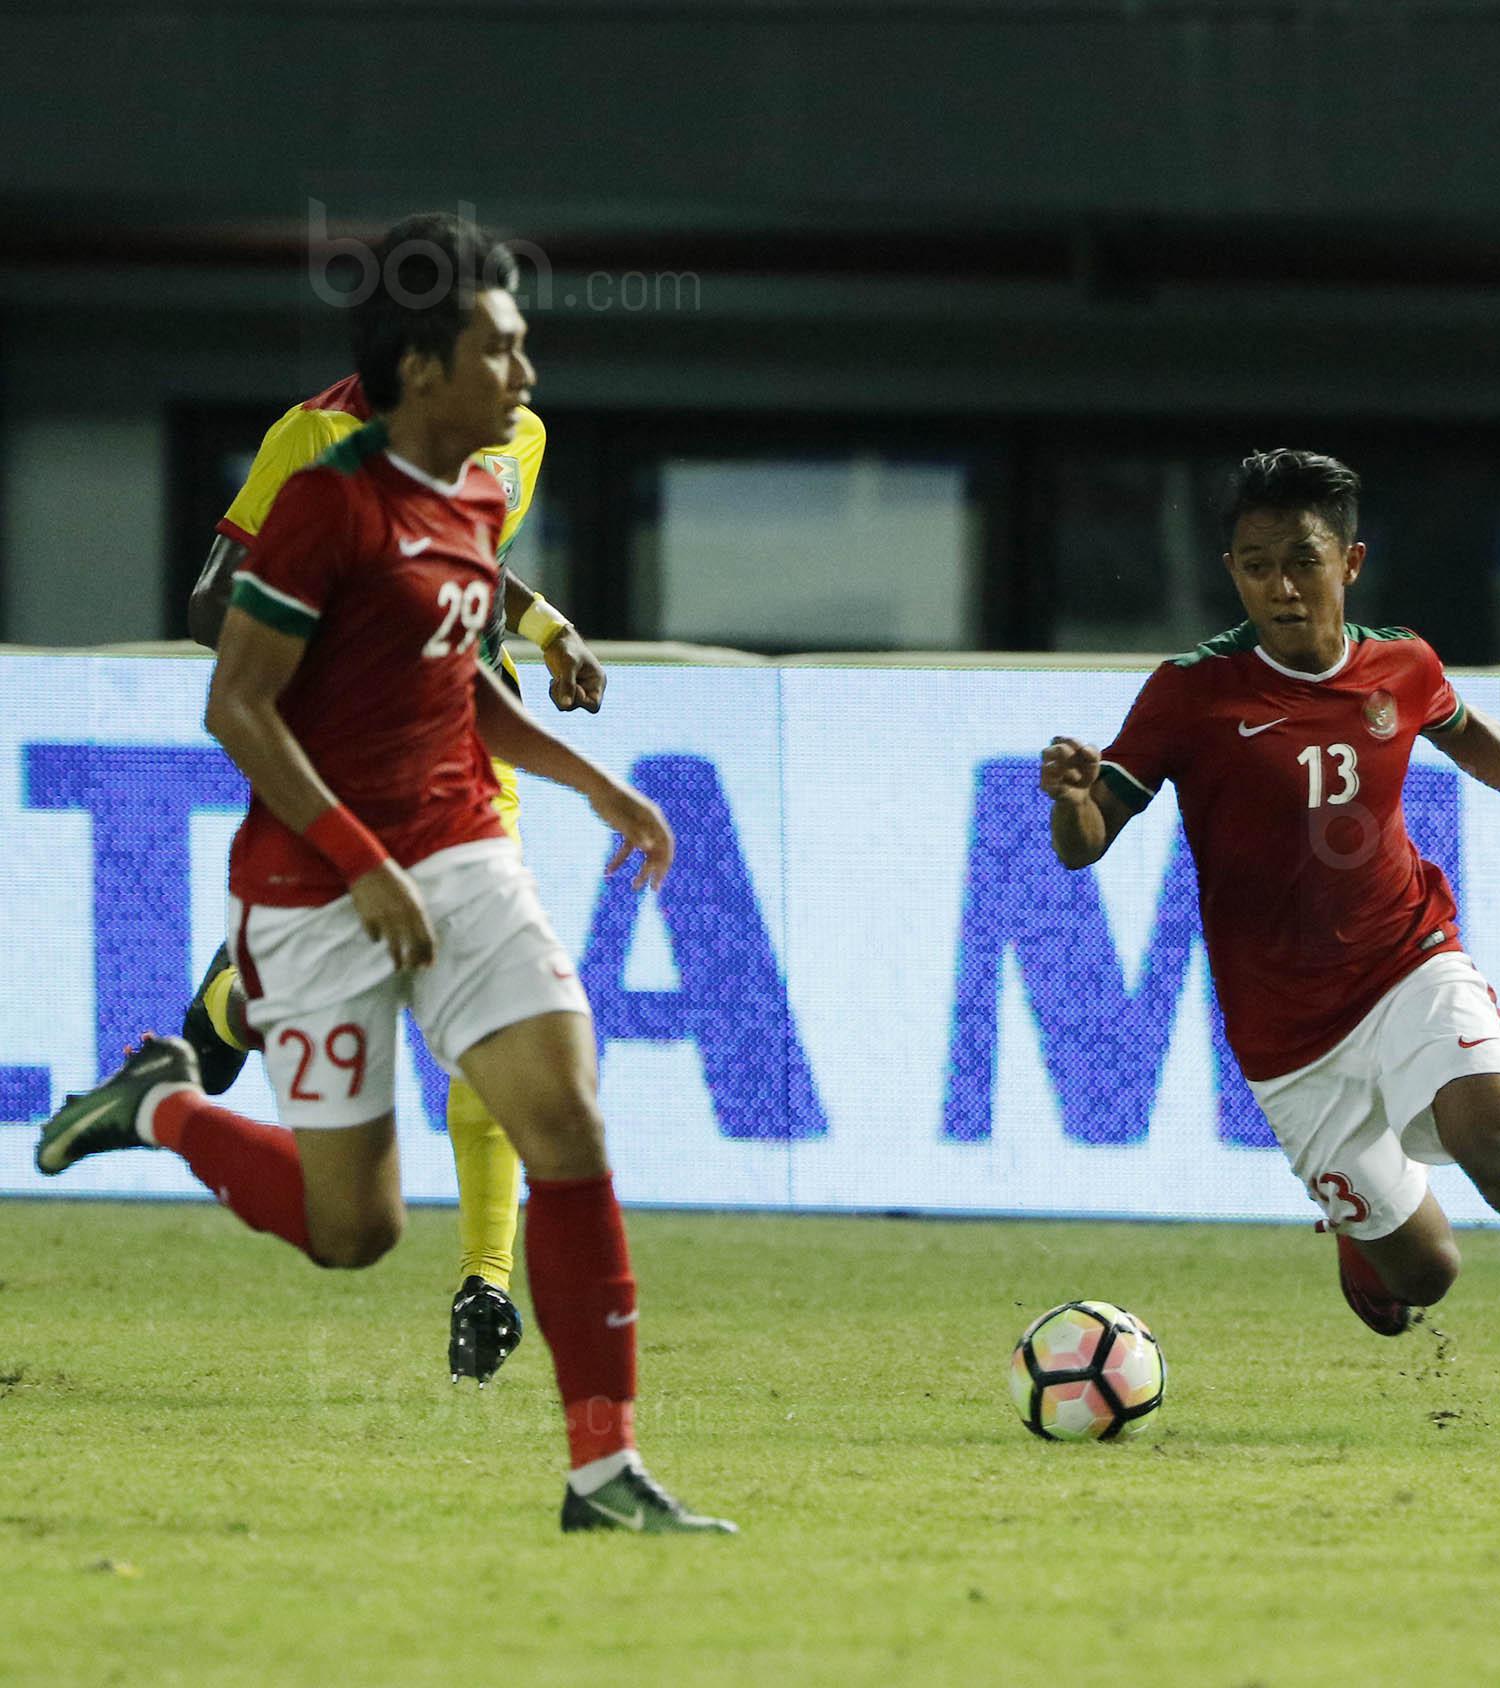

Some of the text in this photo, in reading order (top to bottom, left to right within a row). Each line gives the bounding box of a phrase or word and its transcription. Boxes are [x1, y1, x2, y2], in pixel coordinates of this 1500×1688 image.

[421, 580, 490, 659] 29
[1296, 743, 1360, 809] 13
[278, 1022, 367, 1101] 29
